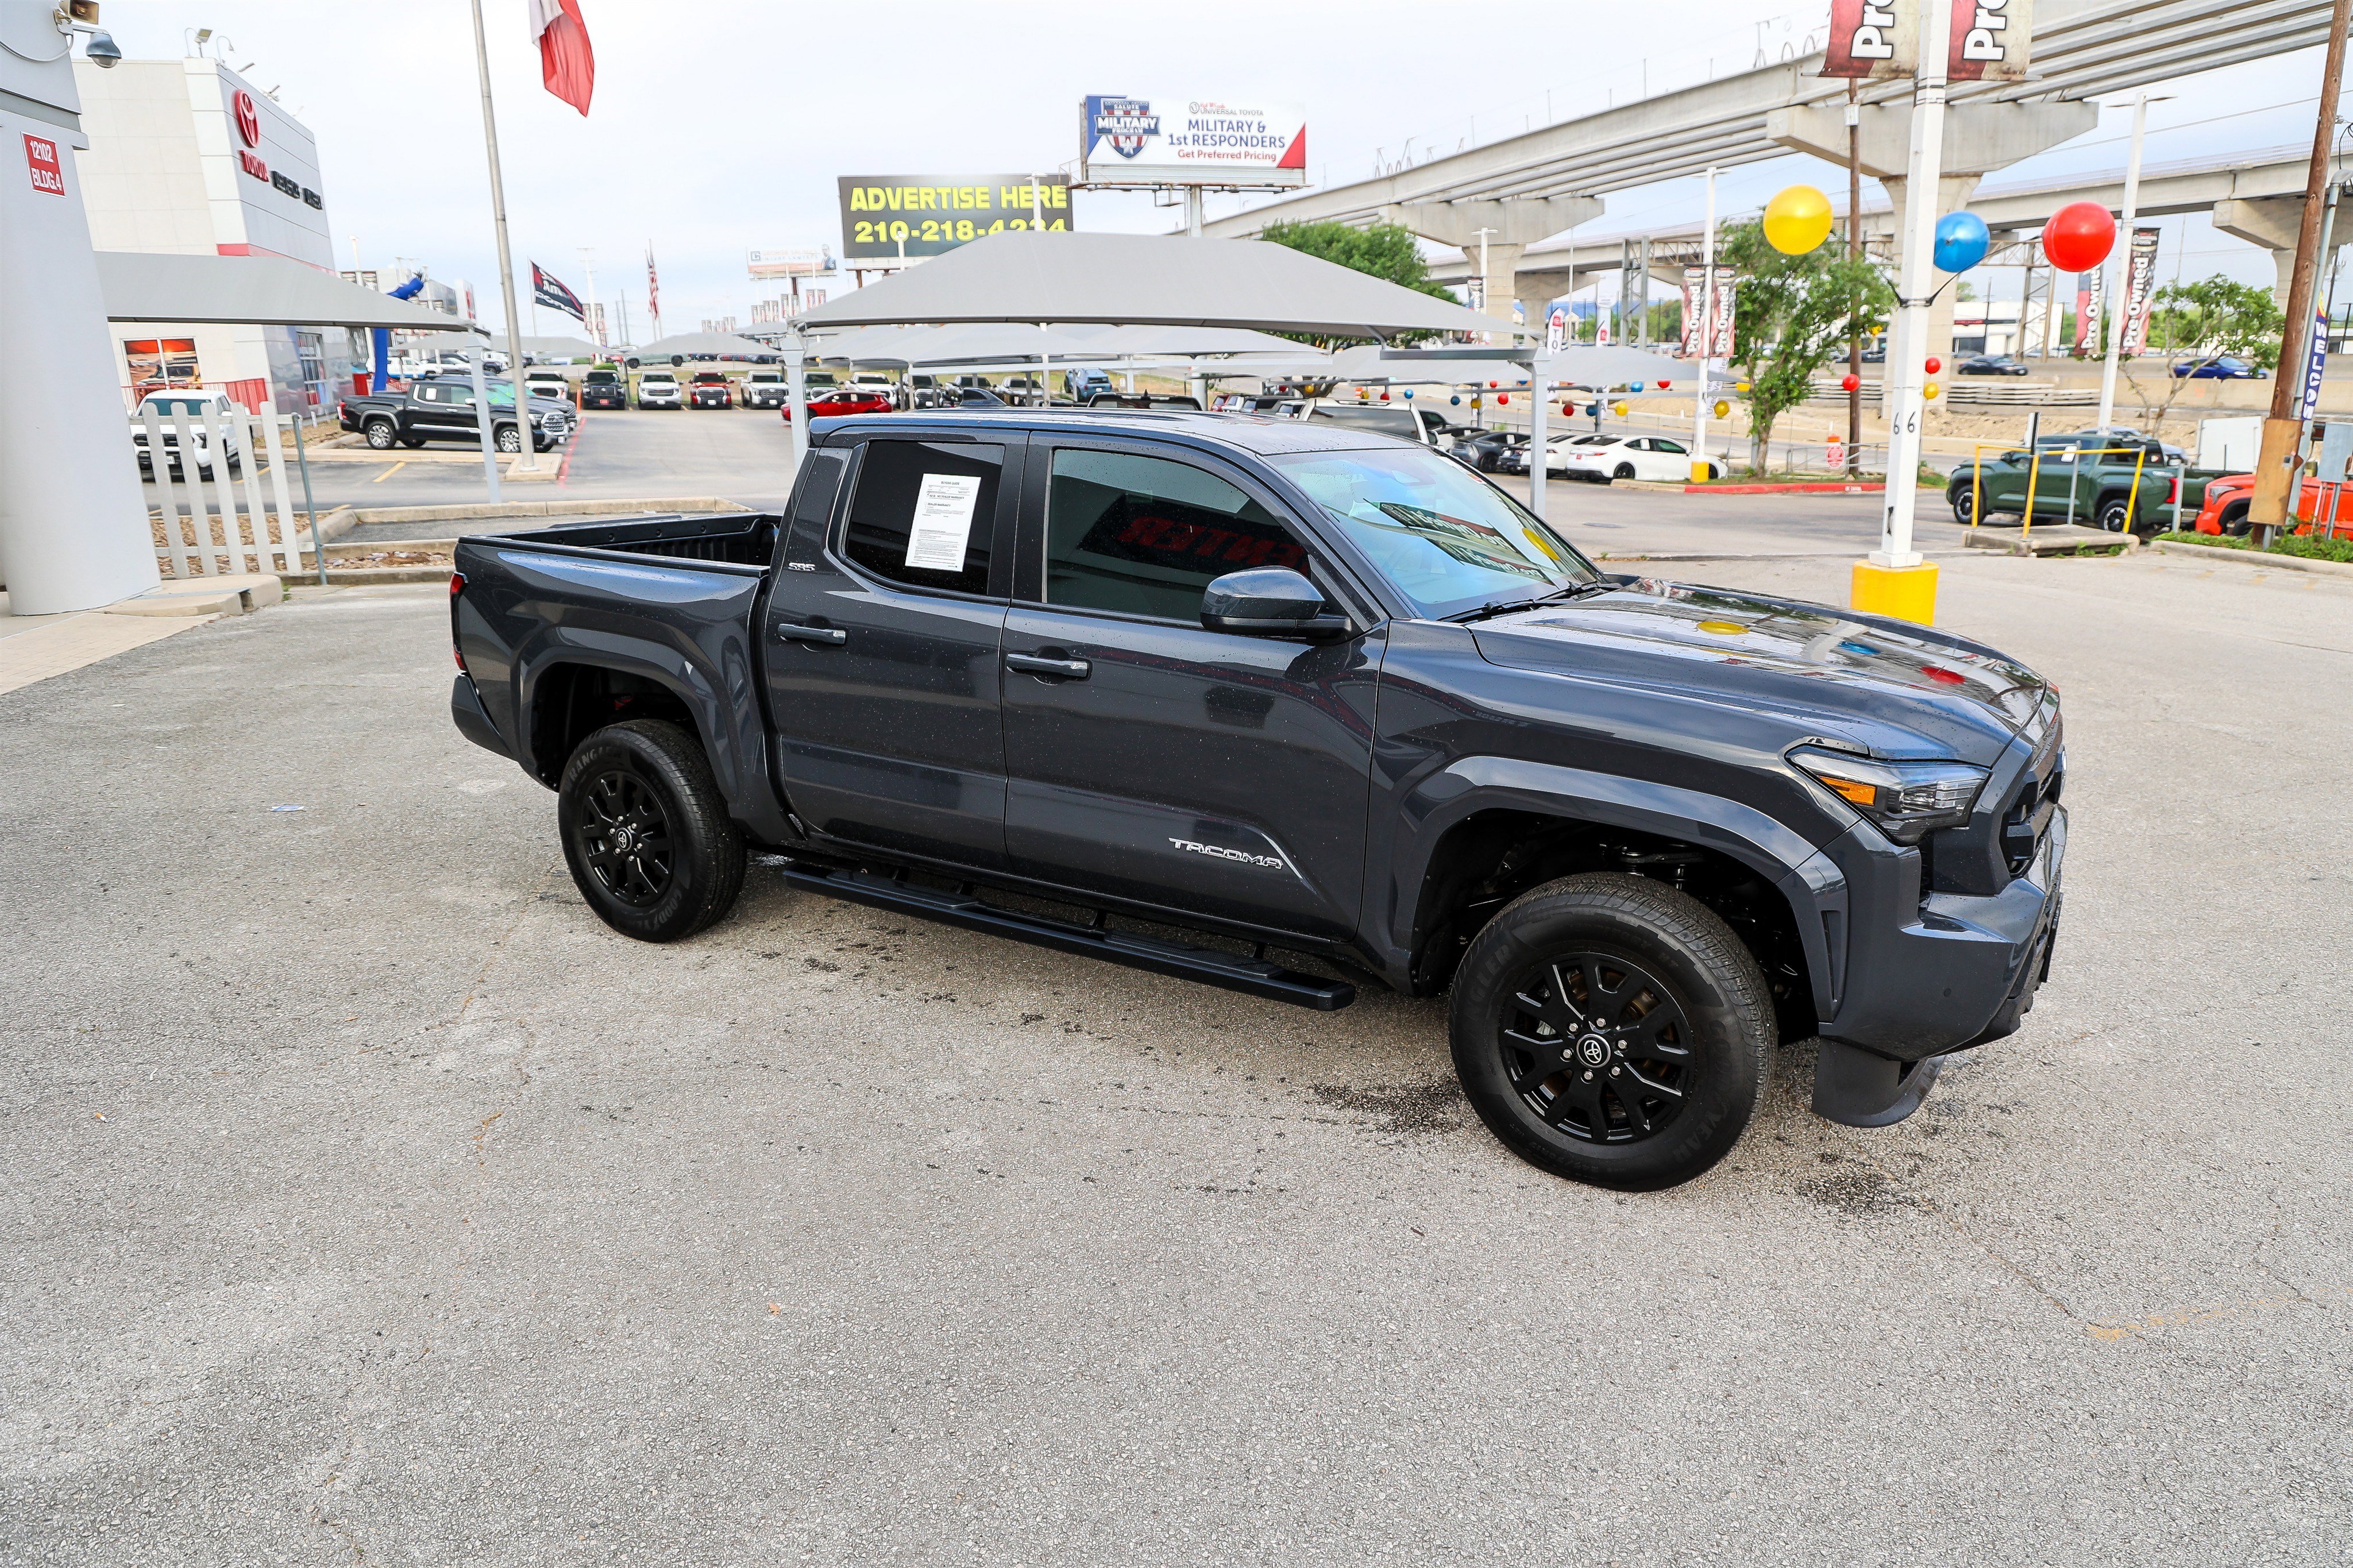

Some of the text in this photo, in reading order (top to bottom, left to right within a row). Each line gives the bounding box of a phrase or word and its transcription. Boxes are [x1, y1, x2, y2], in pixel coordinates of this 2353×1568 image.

[1851, 0, 1895, 58] Pr
[1964, 0, 2008, 60] Pr
[1097, 117, 1157, 129] MILITARY
[1188, 118, 1266, 133] MILITARY &
[29, 140, 55, 163] 12102
[1168, 133, 1286, 148] 1st RESPONDERS
[1178, 149, 1276, 162] Get Preferred Pricing
[850, 184, 1068, 212] ADVERTISE HERE
[2127, 257, 2150, 316] Owned
[1688, 285, 1701, 330] Owned
[1717, 285, 1730, 330] Owned
[1685, 330, 1700, 353] Pre
[1715, 331, 1729, 353] Pre
[2080, 319, 2099, 349] Pre
[2123, 318, 2140, 347] Pre
[788, 562, 816, 571] SR5
[1168, 837, 1284, 870] TACOMA
